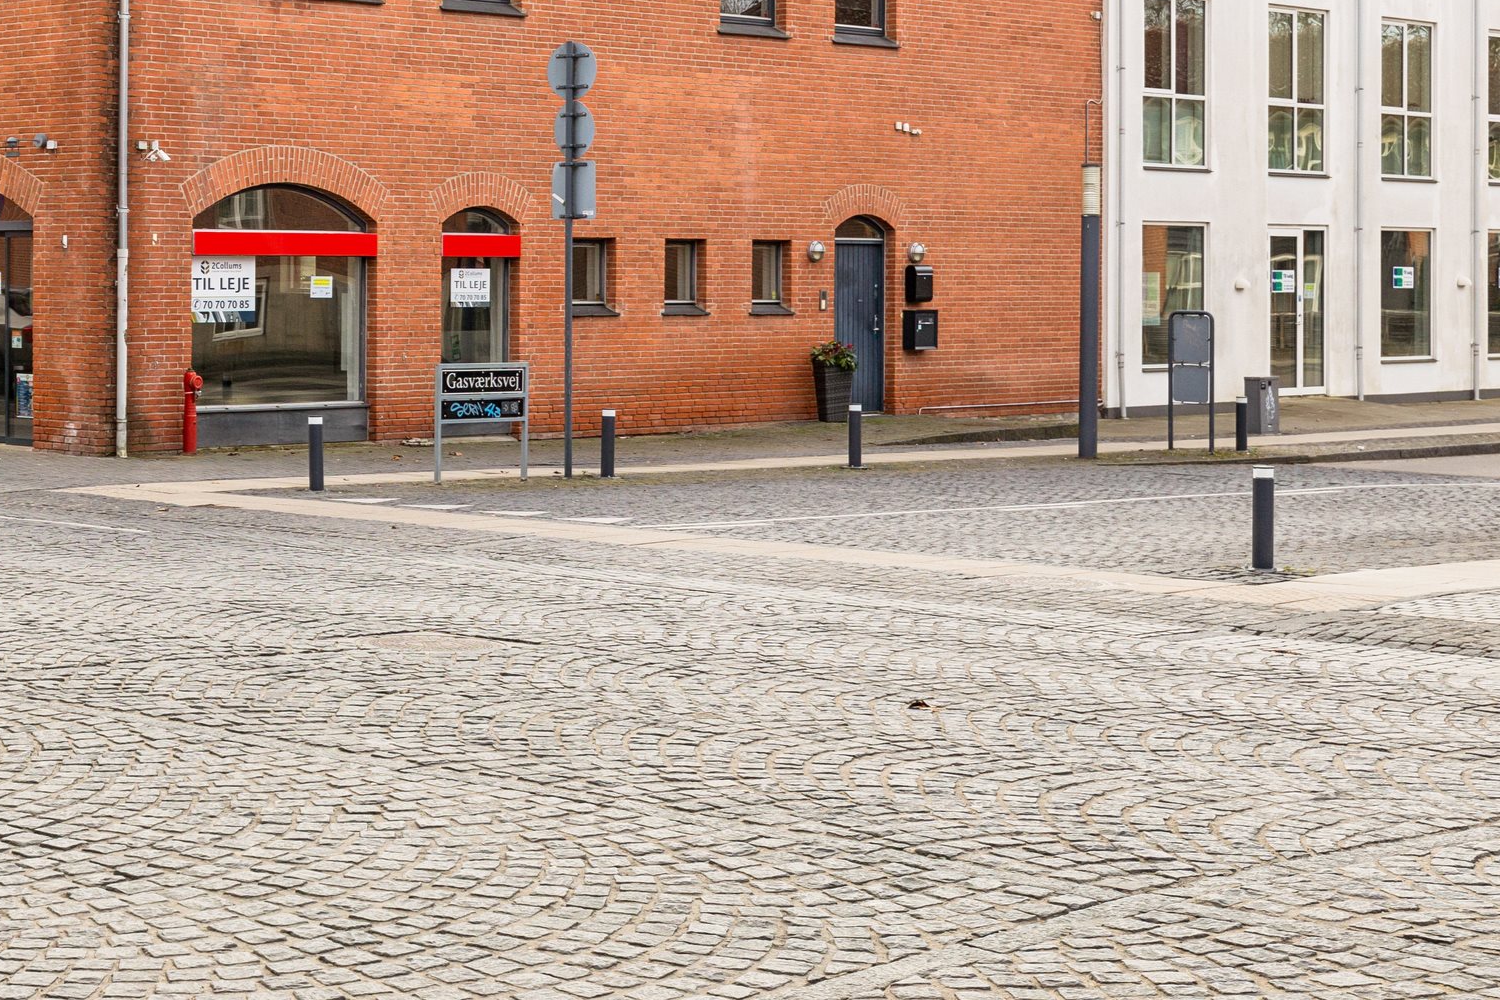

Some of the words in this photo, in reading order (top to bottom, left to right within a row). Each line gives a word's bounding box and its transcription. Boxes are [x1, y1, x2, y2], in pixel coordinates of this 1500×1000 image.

[212, 262, 242, 270] 2Collums
[193, 278, 215, 290] TIL
[220, 278, 250, 293] LEJE
[454, 281, 467, 289] TIL
[470, 281, 487, 291] LEJE
[203, 301, 213, 309] 70
[216, 301, 225, 309] 70
[228, 301, 238, 309] 70
[240, 301, 250, 309] 85
[446, 372, 519, 391] Gasværksvej
